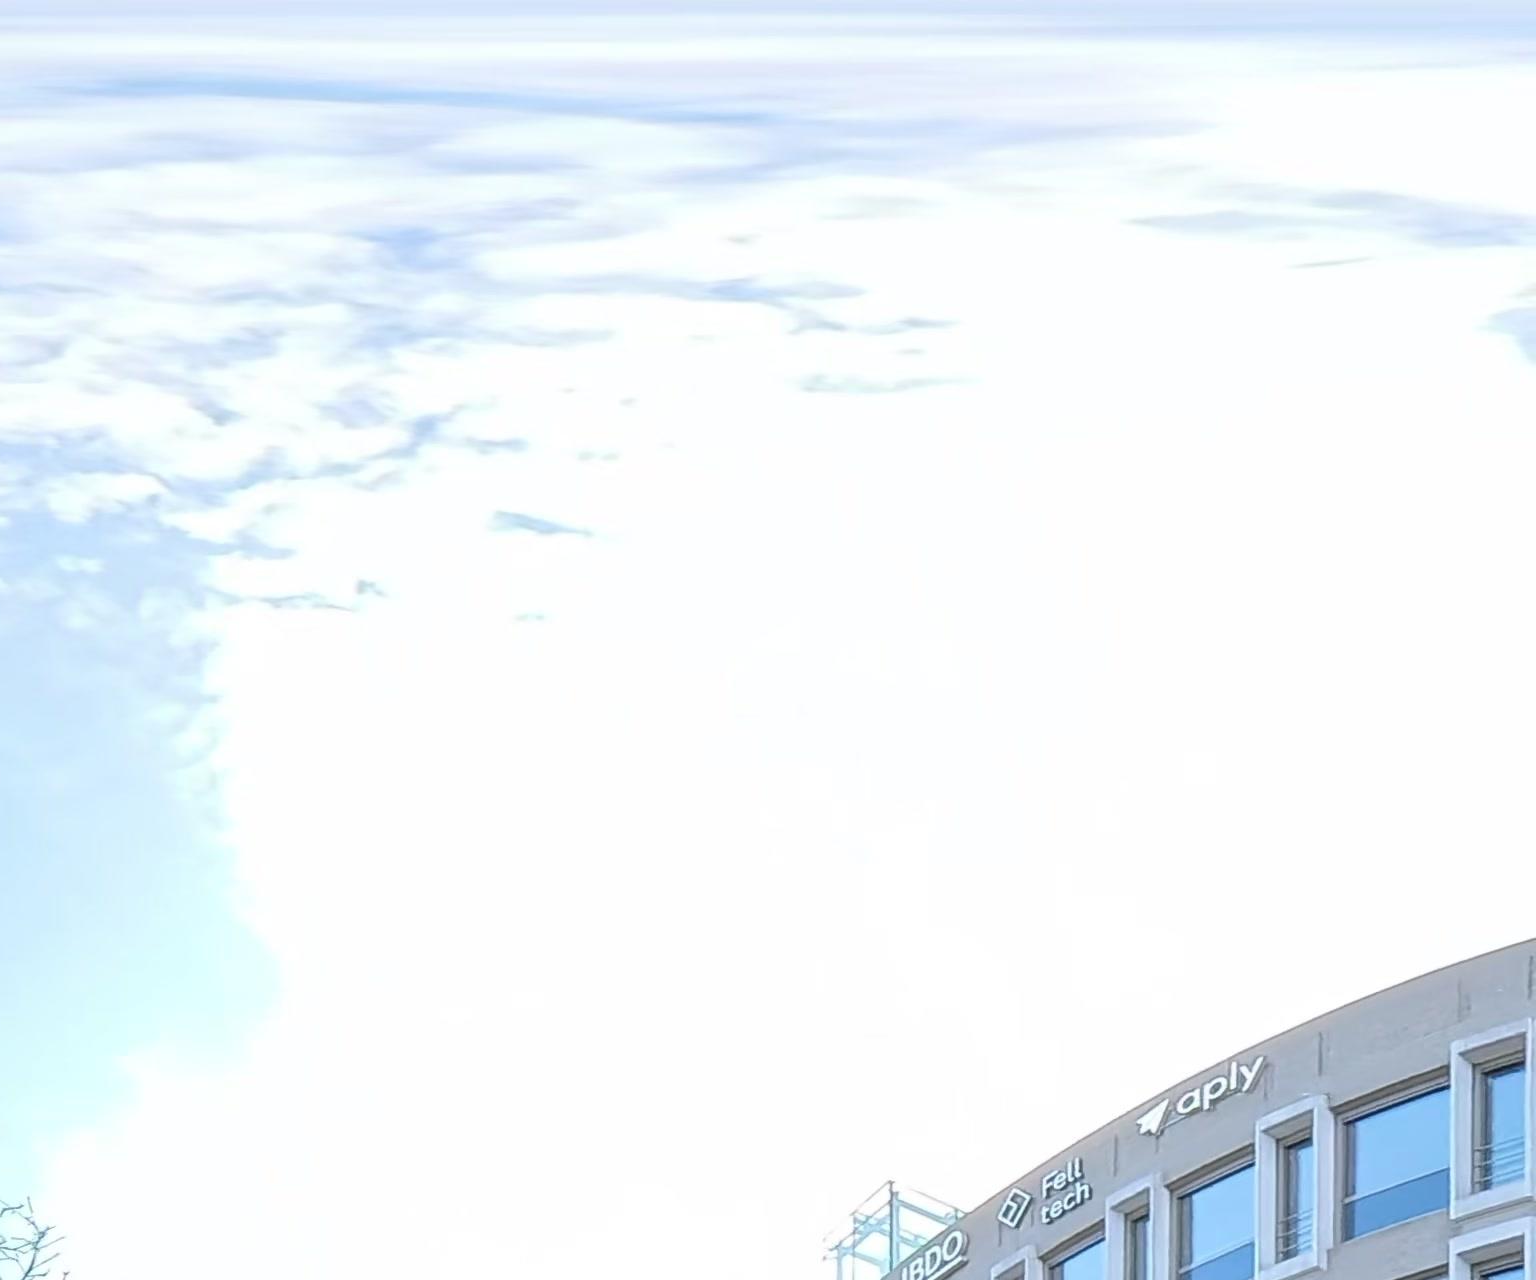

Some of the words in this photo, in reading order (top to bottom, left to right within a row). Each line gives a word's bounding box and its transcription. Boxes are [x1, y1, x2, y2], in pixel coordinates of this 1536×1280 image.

[1176, 1056, 1265, 1115] aply
[1041, 1157, 1083, 1199] Fell
[1041, 1182, 1091, 1225] tech
